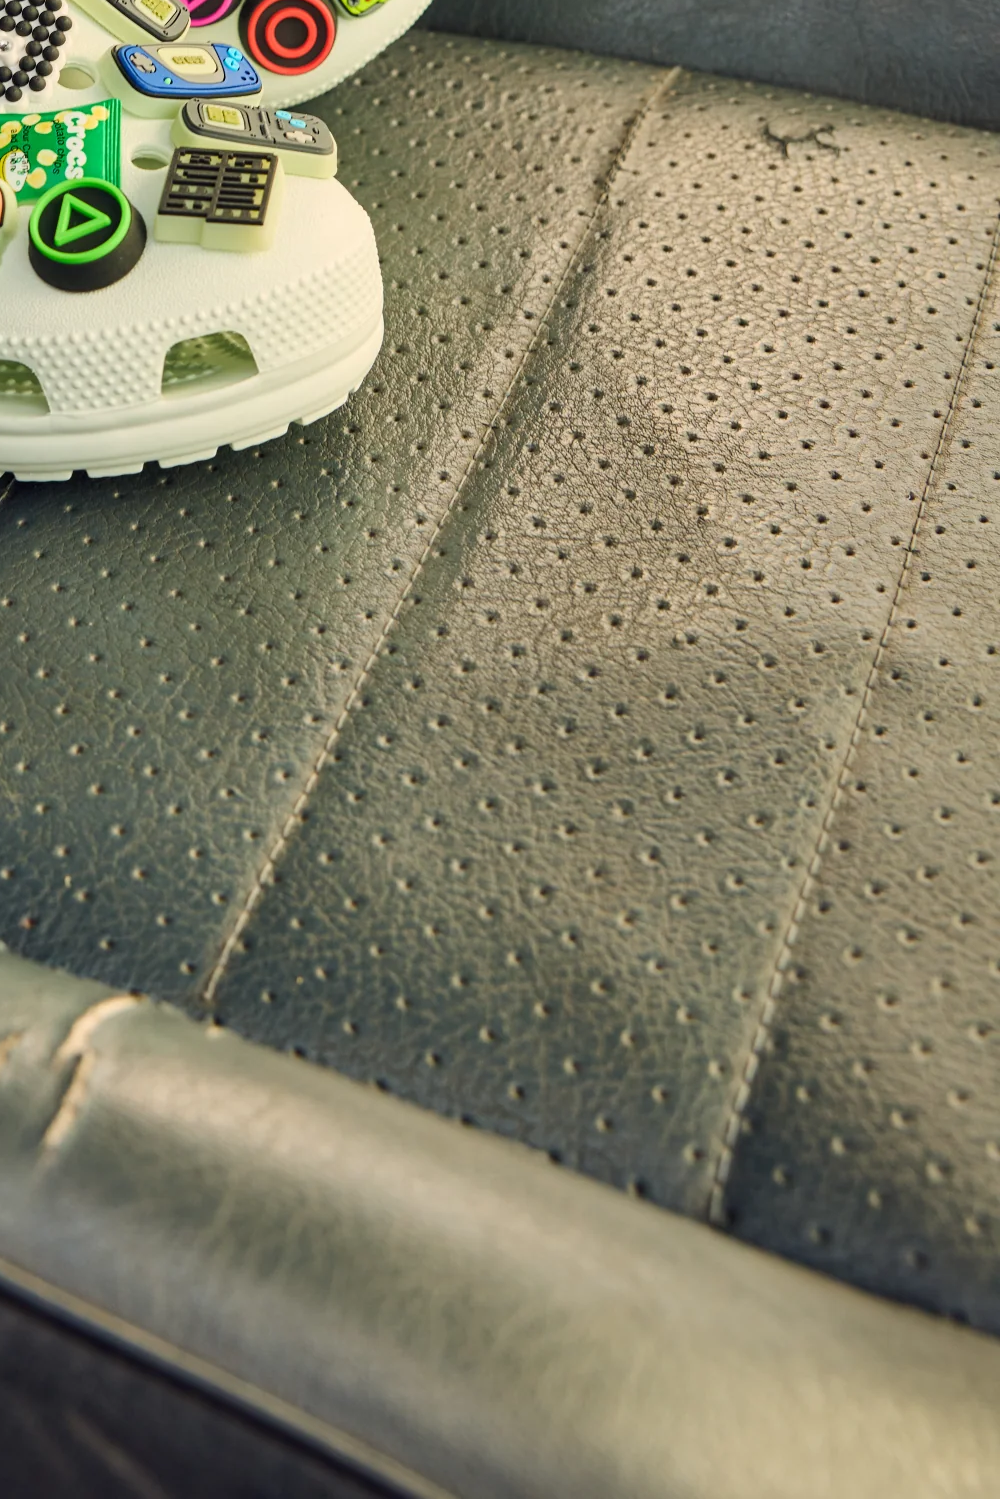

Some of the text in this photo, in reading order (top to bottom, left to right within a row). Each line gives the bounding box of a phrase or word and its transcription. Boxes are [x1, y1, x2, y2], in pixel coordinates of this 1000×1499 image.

[10, 129, 18, 143] and
[21, 125, 31, 174] Sour Cream
[52, 118, 66, 175] potato chips
